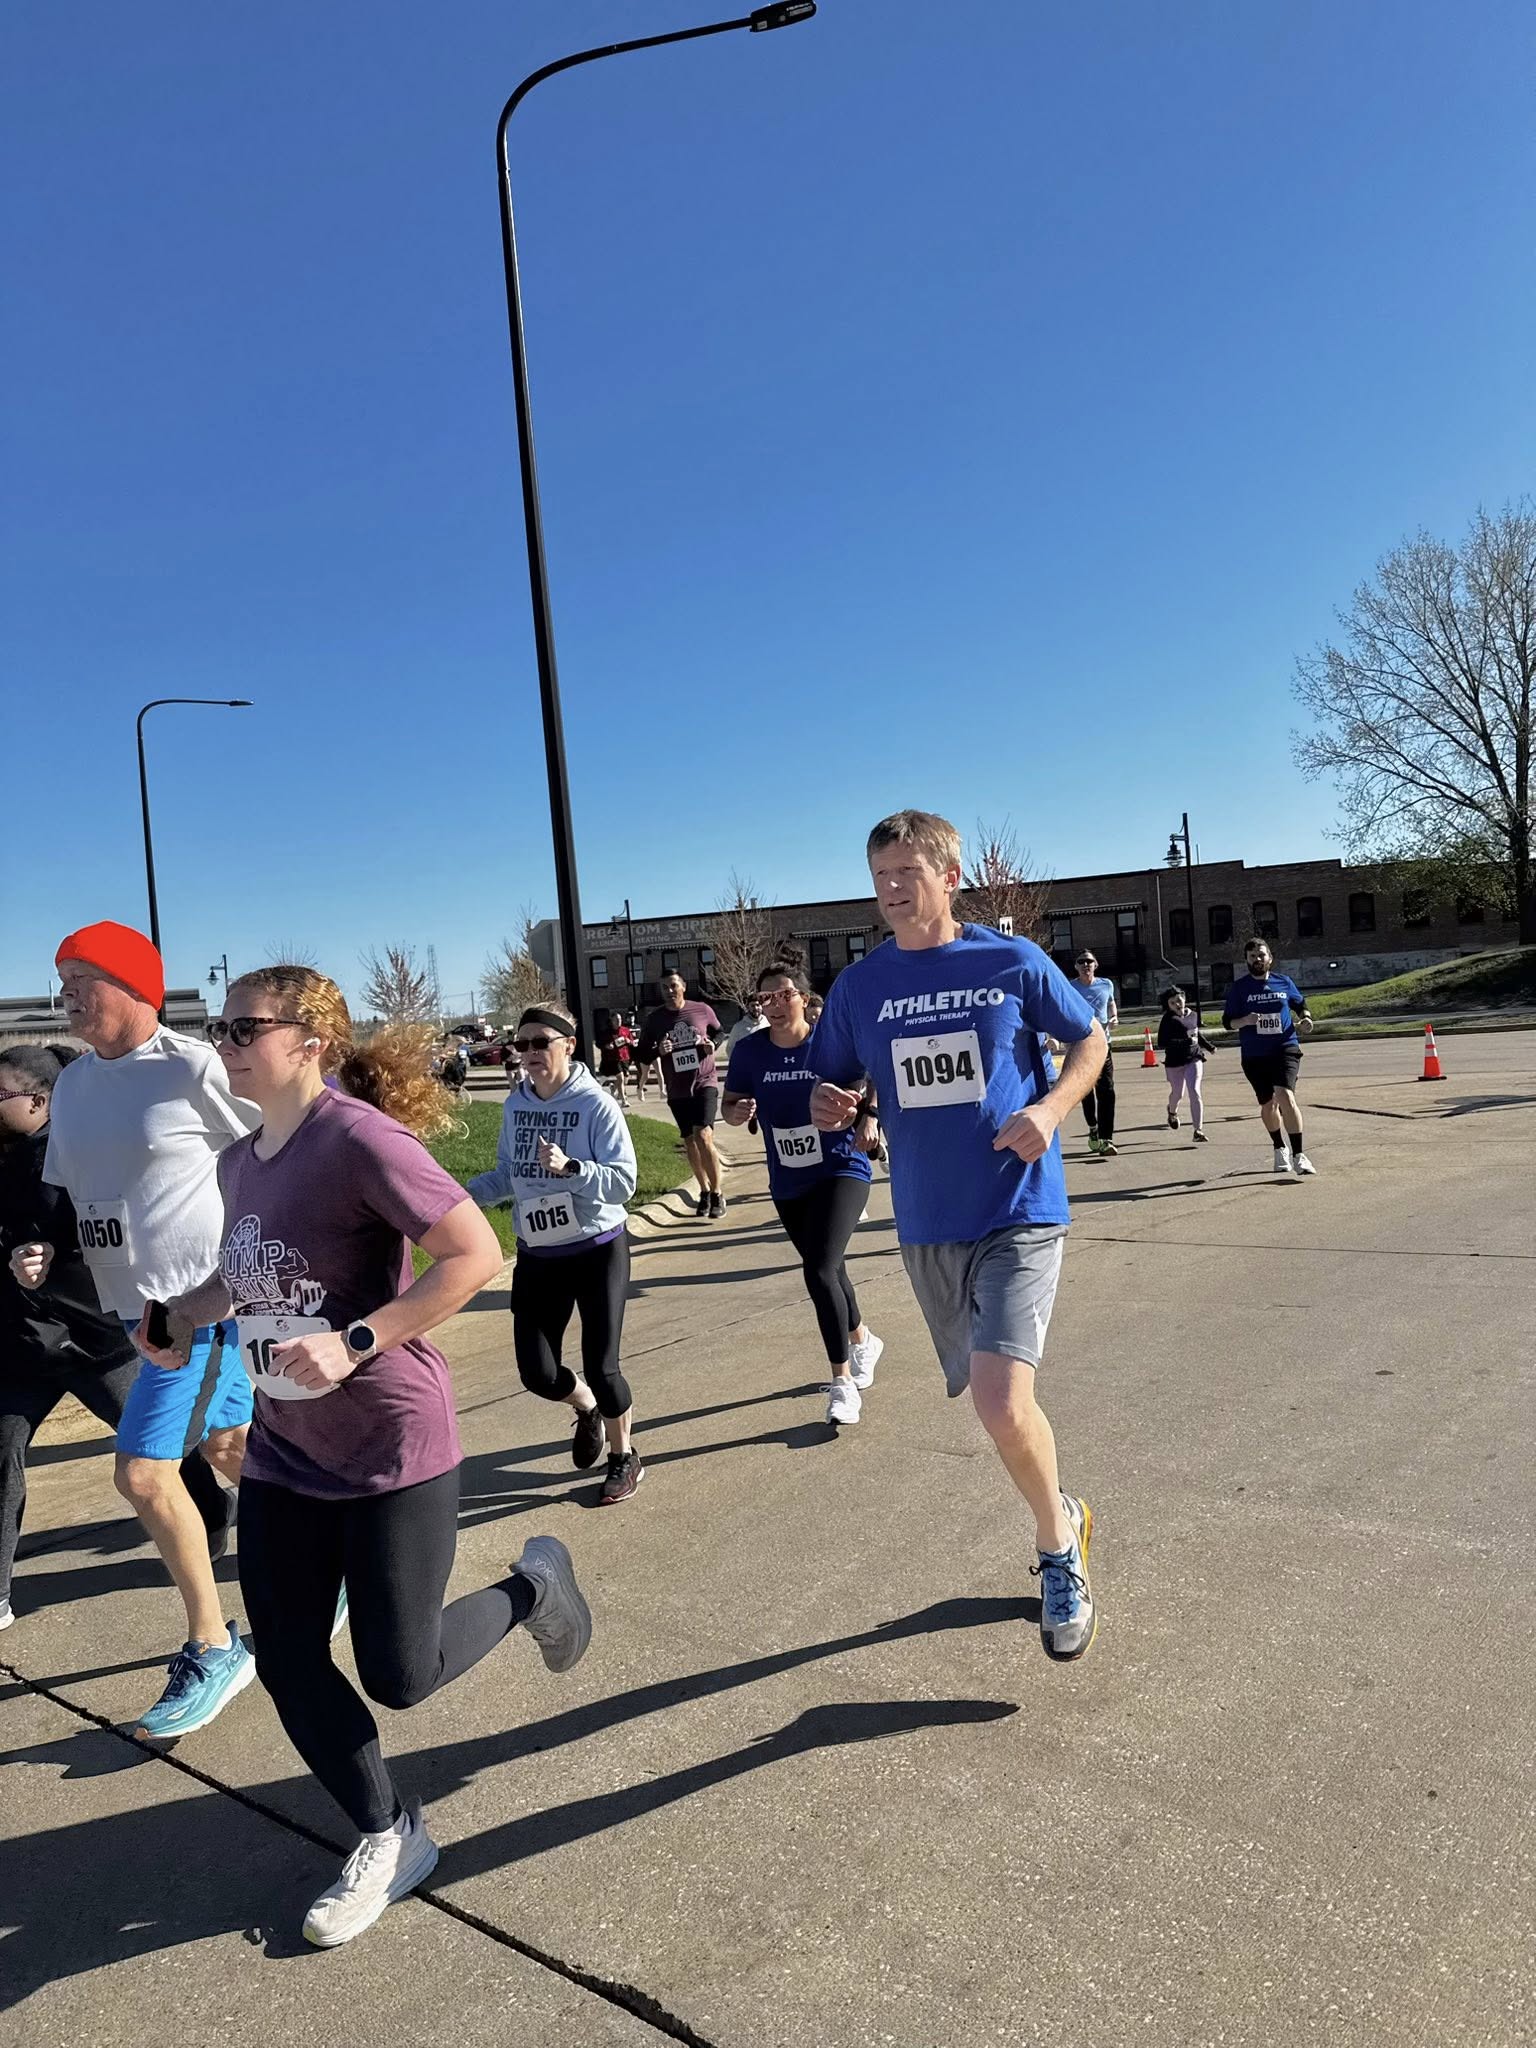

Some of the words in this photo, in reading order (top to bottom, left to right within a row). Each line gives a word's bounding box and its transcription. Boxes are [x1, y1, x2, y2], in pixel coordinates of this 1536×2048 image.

[877, 988, 1005, 1023] ATHLETICO
[905, 1013, 938, 1026] PHYSICAL
[939, 1010, 971, 1022] THERAPY
[1259, 1018, 1280, 1029] 1090
[676, 1054, 696, 1066] 1076
[901, 1050, 975, 1087] 1094
[763, 1070, 819, 1083] ATHLETIC
[513, 1110, 557, 1128] TRYING
[562, 1112, 580, 1128] TO
[515, 1128, 537, 1144] GET
[778, 1135, 816, 1156] 1052
[514, 1144, 533, 1160] MY
[526, 1205, 570, 1232] 1015
[79, 1218, 123, 1248] 1050
[231, 1274, 285, 1300] RUN
[246, 1338, 281, 1377] 10
